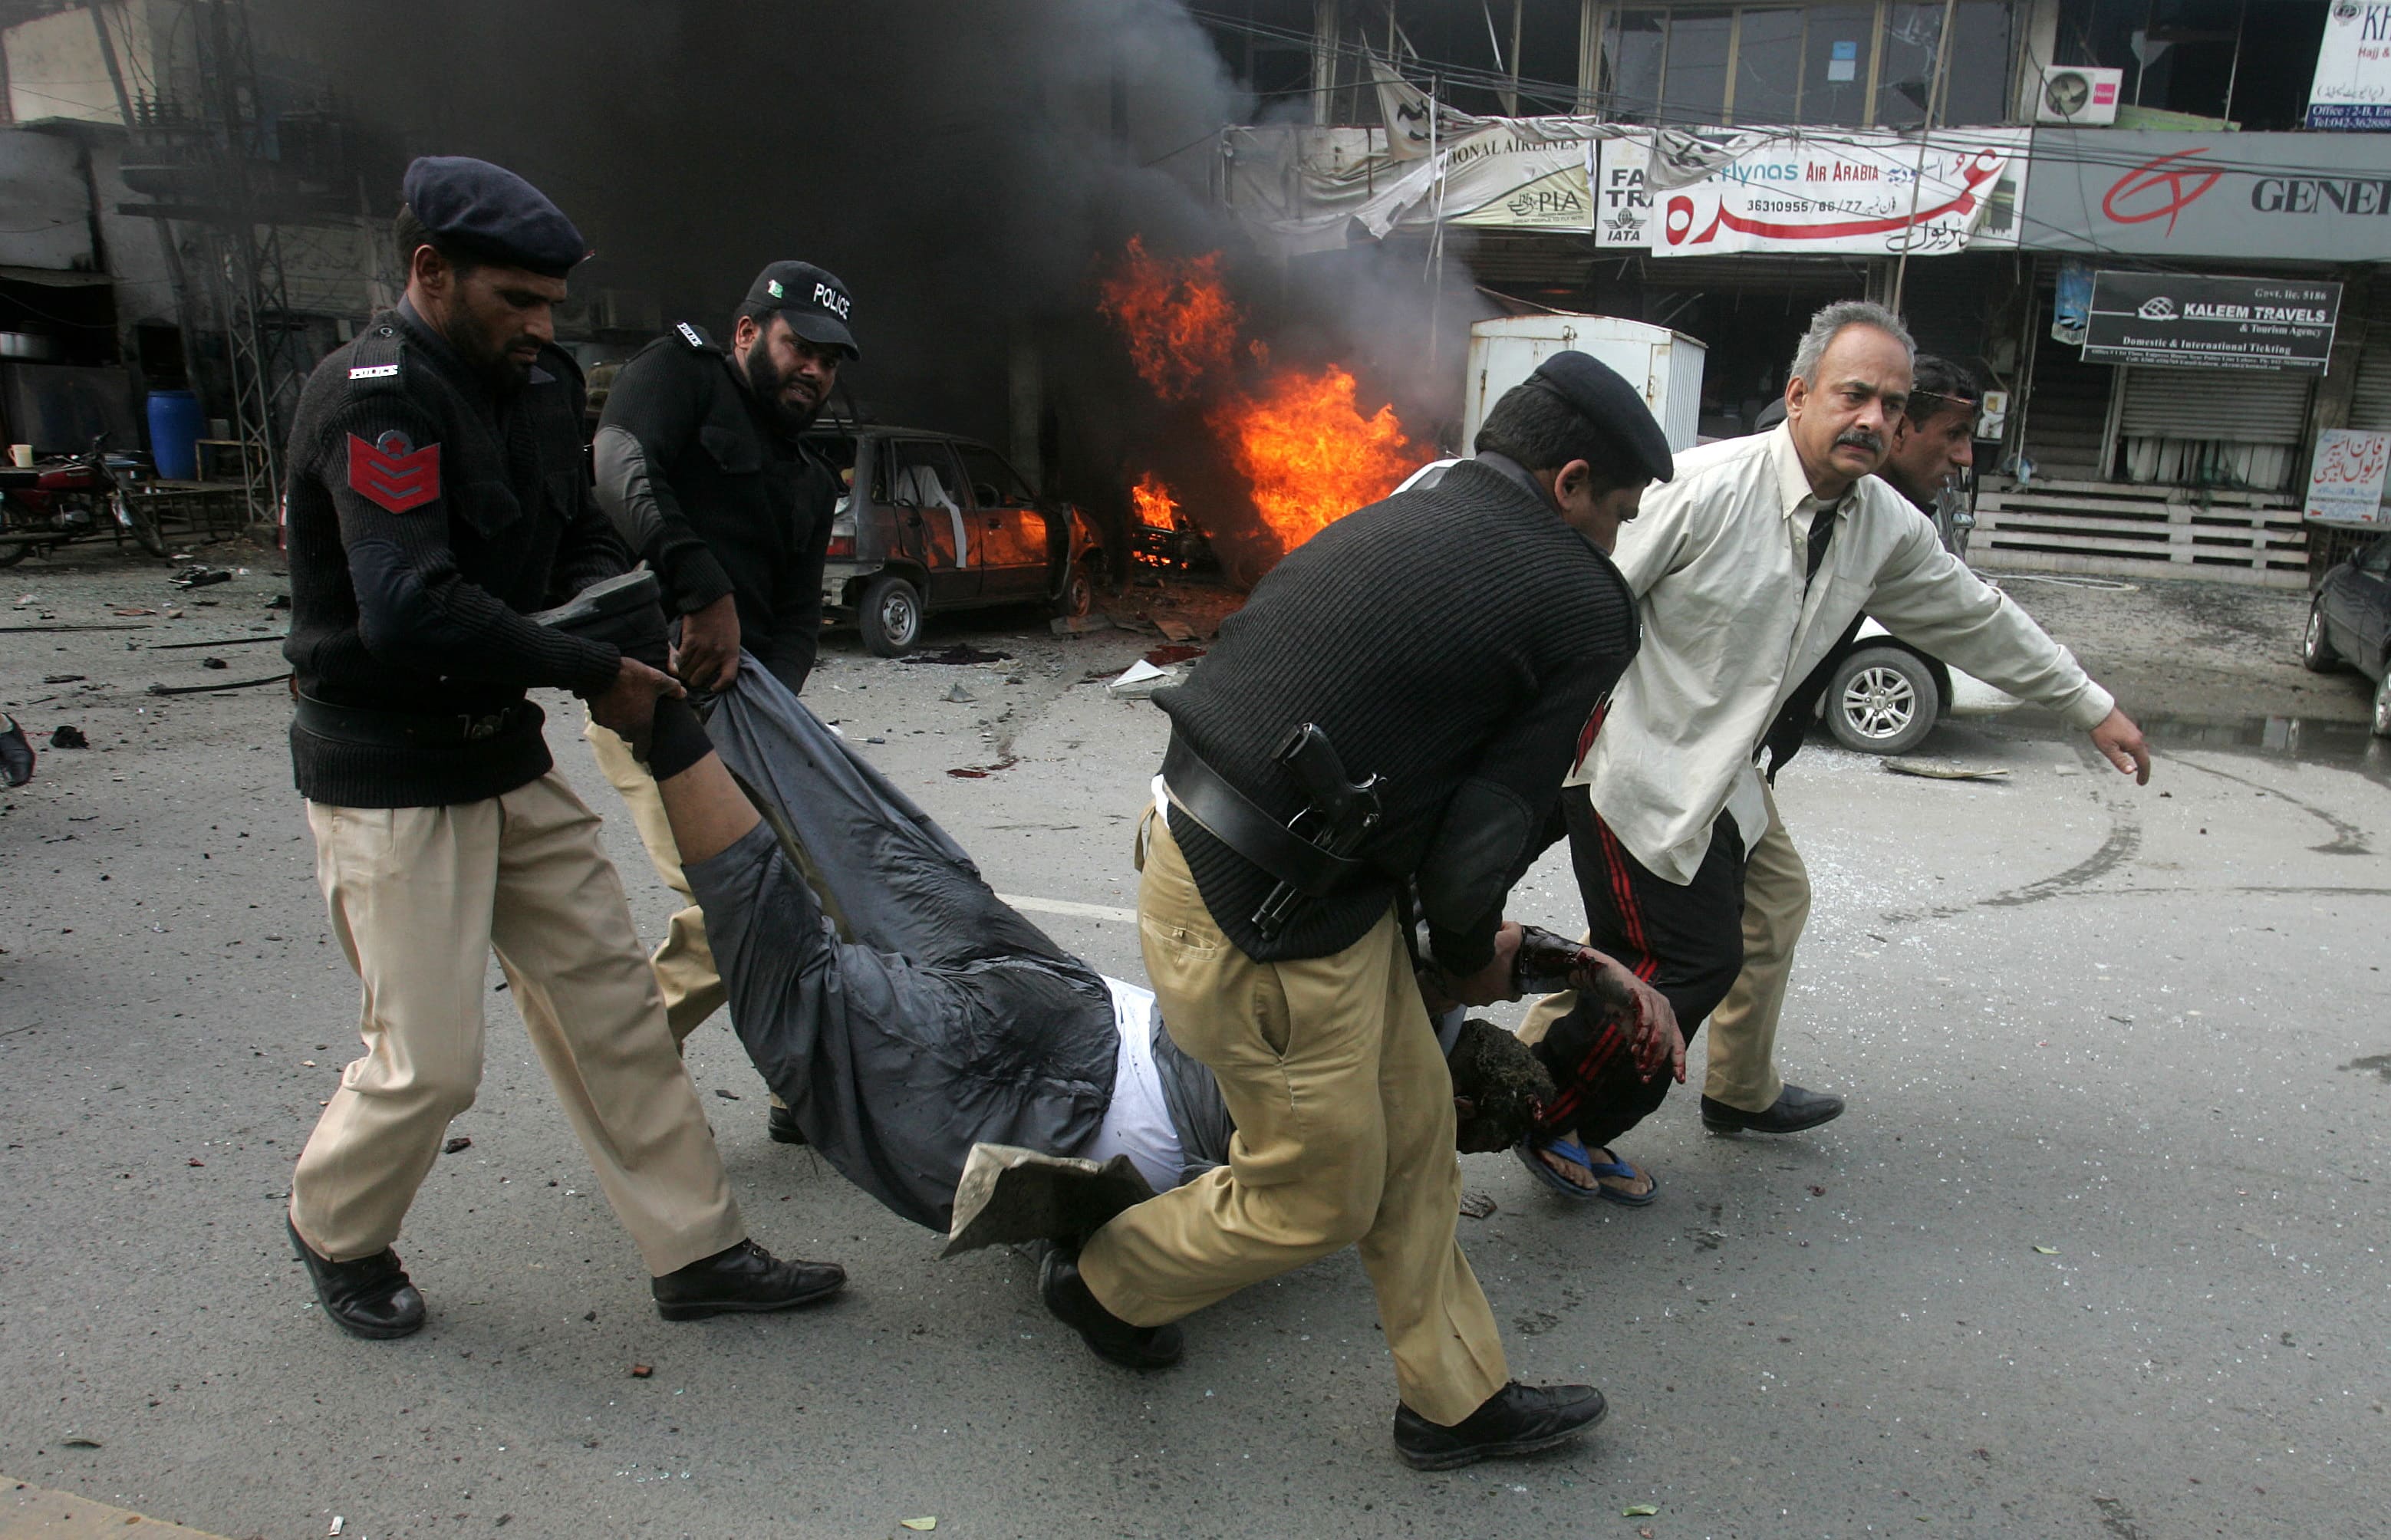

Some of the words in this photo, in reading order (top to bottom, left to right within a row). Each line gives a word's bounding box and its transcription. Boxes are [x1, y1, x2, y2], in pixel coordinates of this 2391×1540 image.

[2358, 47, 2379, 60] Hajj
[2382, 48, 2390, 58] &
[2313, 106, 2343, 116] Office
[1721, 159, 1798, 187] flynas
[1806, 160, 1826, 182] AIR
[1833, 160, 1879, 182] ARABIA
[1539, 189, 1582, 212] PIA
[1607, 231, 1640, 241] IATA
[813, 282, 851, 321] POLICE
[2254, 288, 2282, 300] Govt.
[2284, 289, 2300, 300] lic.
[2184, 303, 2249, 319] KALEEM
[2254, 307, 2327, 323] TRAVELS
[2239, 323, 2248, 333] &
[2251, 324, 2288, 335] Tourism
[2289, 326, 2323, 338] Agency
[2123, 336, 2167, 348] Domestic
[2169, 338, 2179, 349] &
[2182, 340, 2247, 354] International
[2251, 343, 2292, 357] Tickting
